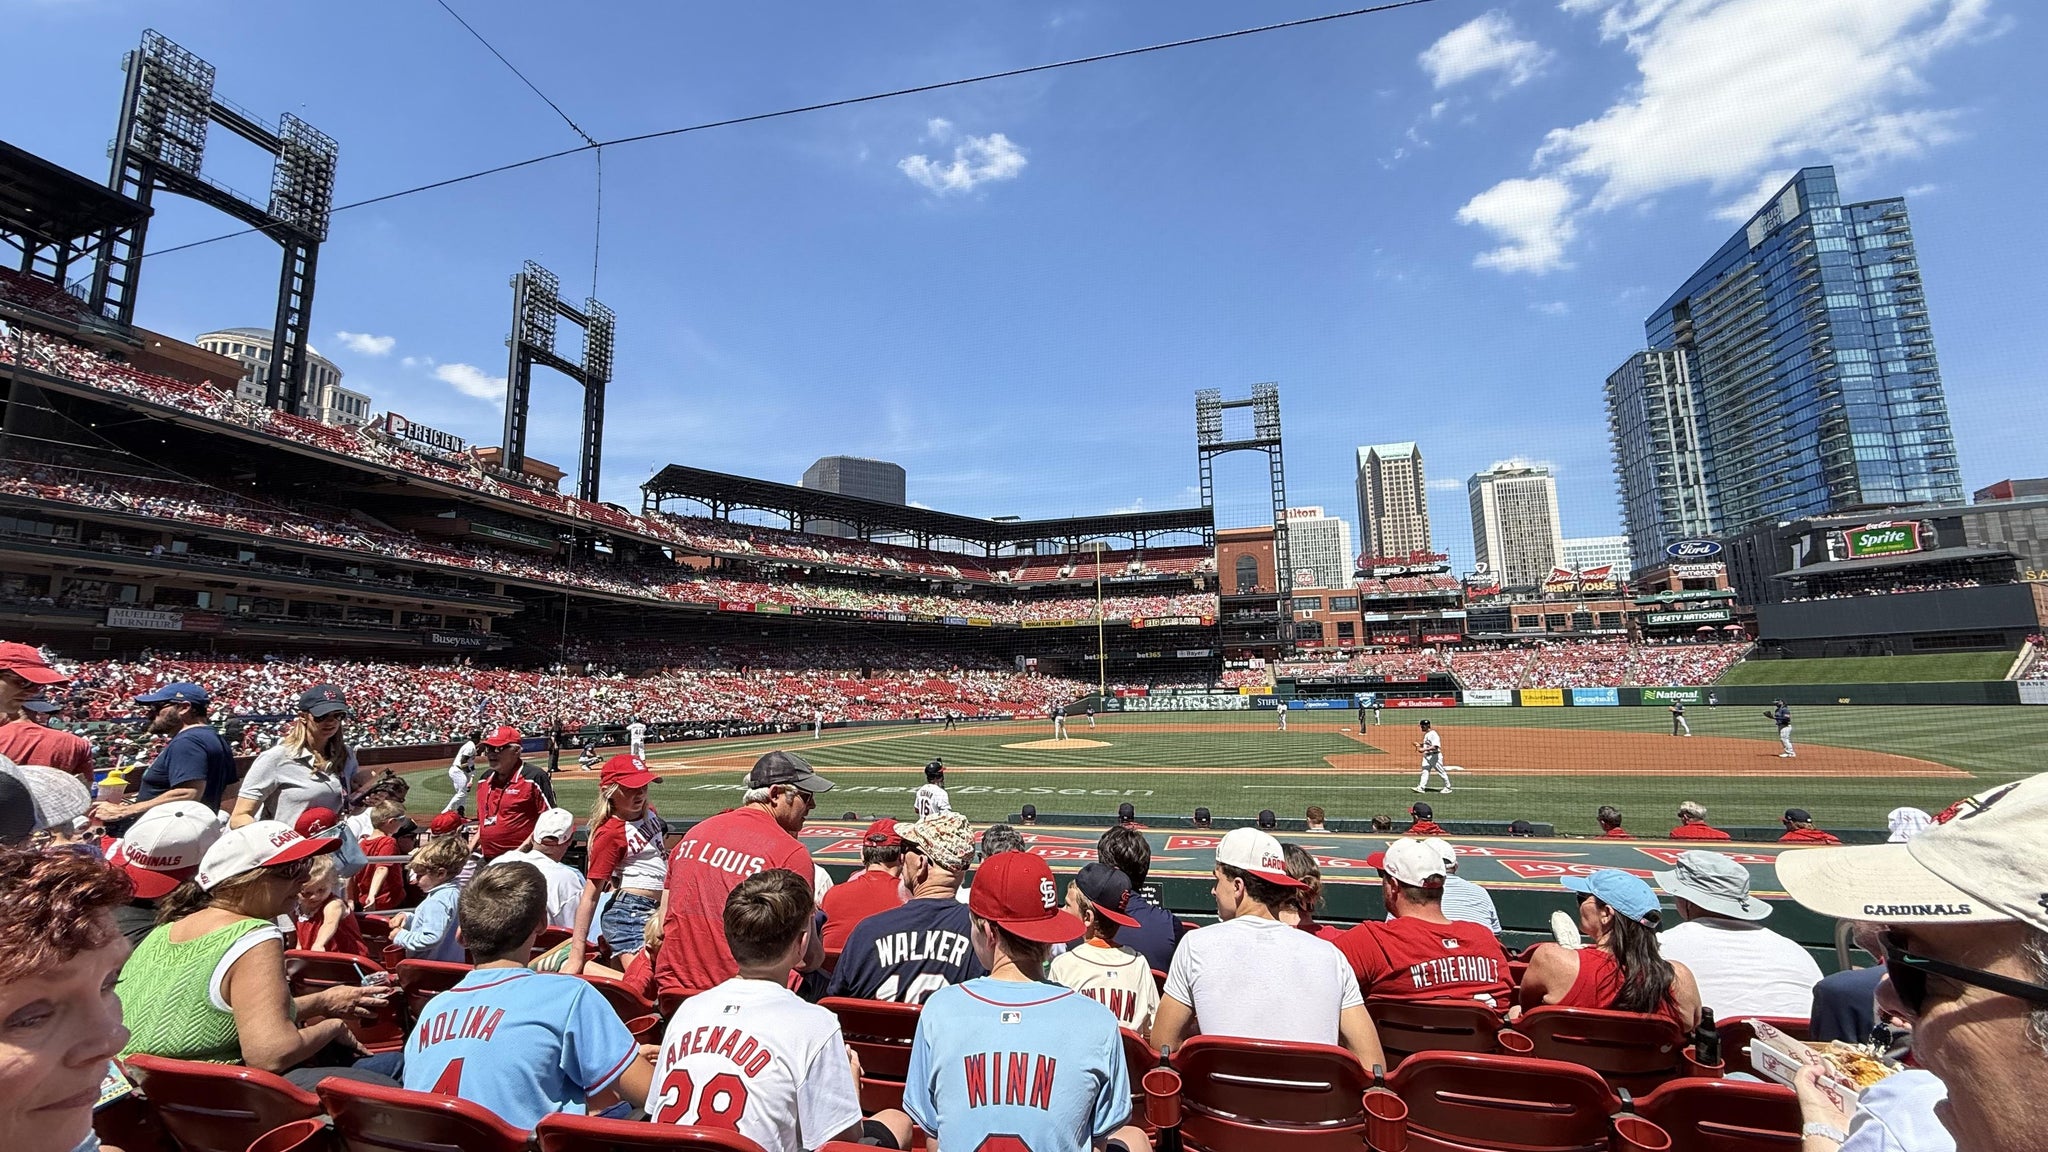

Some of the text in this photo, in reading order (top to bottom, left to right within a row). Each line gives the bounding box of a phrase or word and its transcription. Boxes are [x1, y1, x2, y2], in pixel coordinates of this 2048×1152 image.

[1760, 206, 1780, 225] BUD
[1859, 530, 1905, 547] Sprite
[1678, 542, 1711, 555] Ford
[1672, 561, 1723, 572] Community
[1543, 582, 1574, 593] BREW
[112, 610, 166, 620] MUELLER
[1651, 612, 1725, 622] SAFETY NATIONAL
[113, 618, 178, 628] FURNITURE
[1257, 698, 1279, 706] STIFEL
[1656, 690, 1699, 699] National
[1408, 699, 1443, 707] Budweiser
[920, 798, 930, 816] 16
[125, 845, 183, 867] CARDINALS
[675, 840, 766, 877] ST. LOUIS
[1036, 849, 1098, 859] 194
[1519, 864, 1600, 874] 196
[1863, 904, 1972, 916] CARDINALS
[875, 930, 970, 968] WALKER
[1410, 955, 1499, 989] WETHERHOLT
[418, 1005, 506, 1054] MOLINA
[665, 1025, 772, 1079] ARENADO
[430, 1057, 465, 1097] 4
[963, 1051, 1057, 1112] WINN
[657, 1068, 749, 1133] 28
